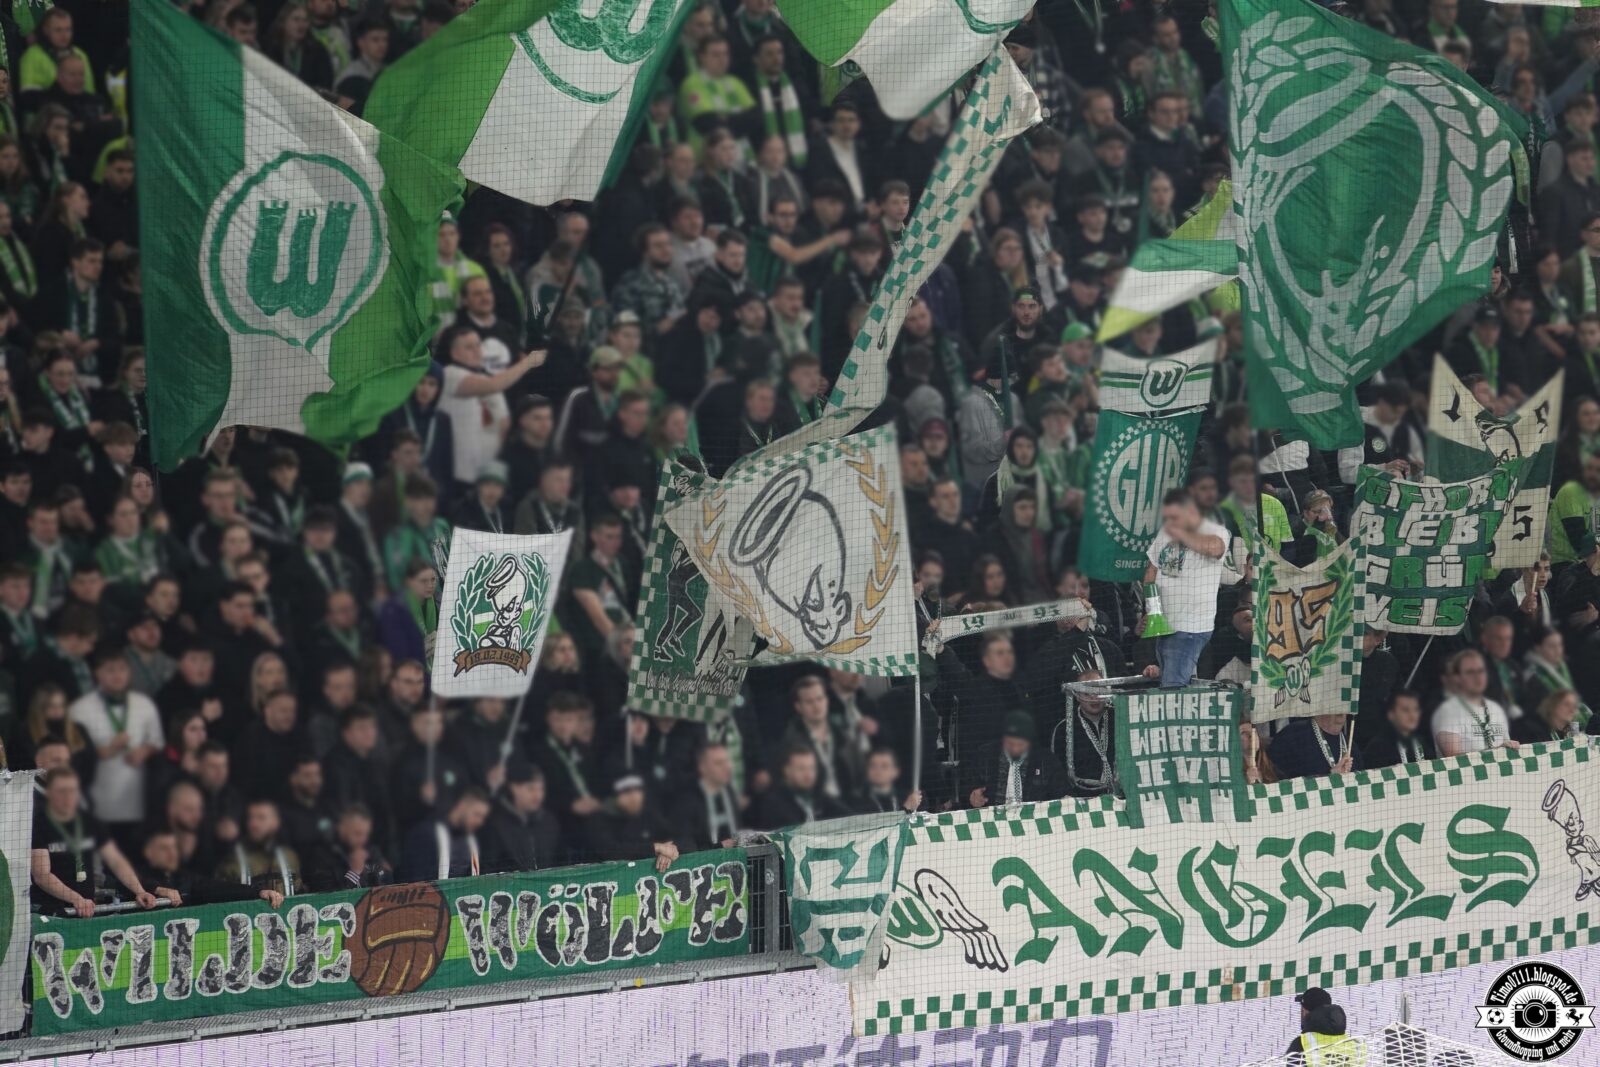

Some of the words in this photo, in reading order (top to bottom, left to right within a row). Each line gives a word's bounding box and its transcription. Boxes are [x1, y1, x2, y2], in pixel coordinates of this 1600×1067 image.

[1114, 559, 1142, 569] SINCE
[1128, 691, 1234, 724] WAHRES
[991, 803, 1541, 967] ANGELS
[34, 903, 357, 1019] WILDE
